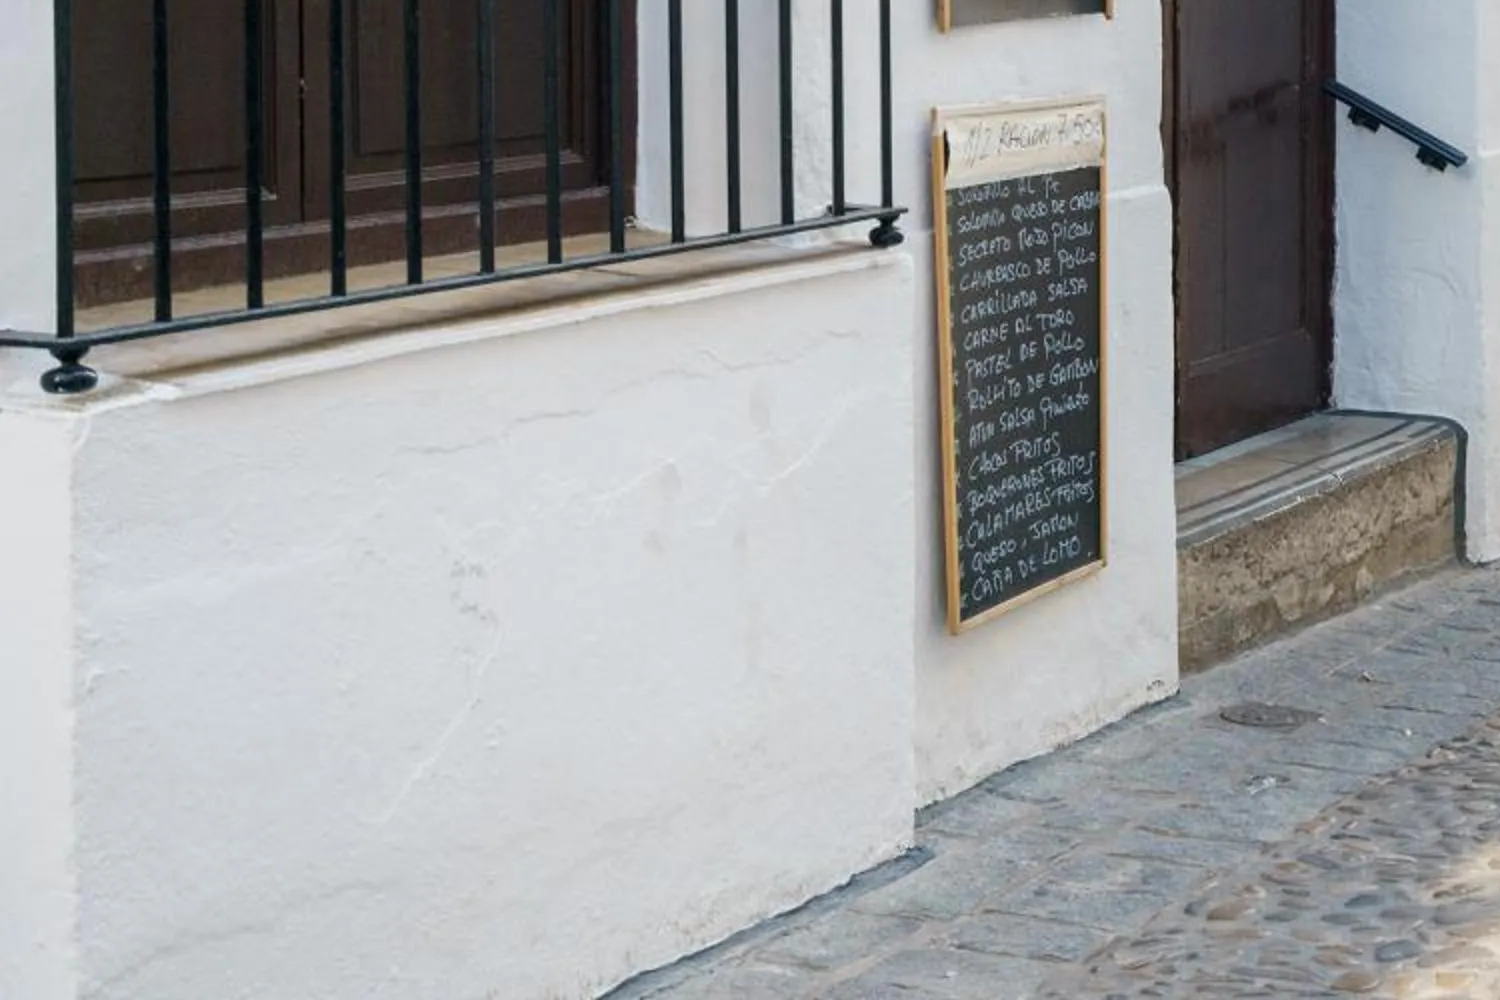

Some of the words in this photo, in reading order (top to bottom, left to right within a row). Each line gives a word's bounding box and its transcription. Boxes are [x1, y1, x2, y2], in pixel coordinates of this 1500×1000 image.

[1052, 199, 1067, 214] DE
[1035, 257, 1052, 275] DE
[963, 322, 1009, 351] CARNE
[1015, 314, 1033, 334] AL
[1020, 341, 1039, 362] DE
[1027, 373, 1046, 393] DE
[1017, 556, 1038, 580] DE
[1042, 535, 1082, 565] LOMO
